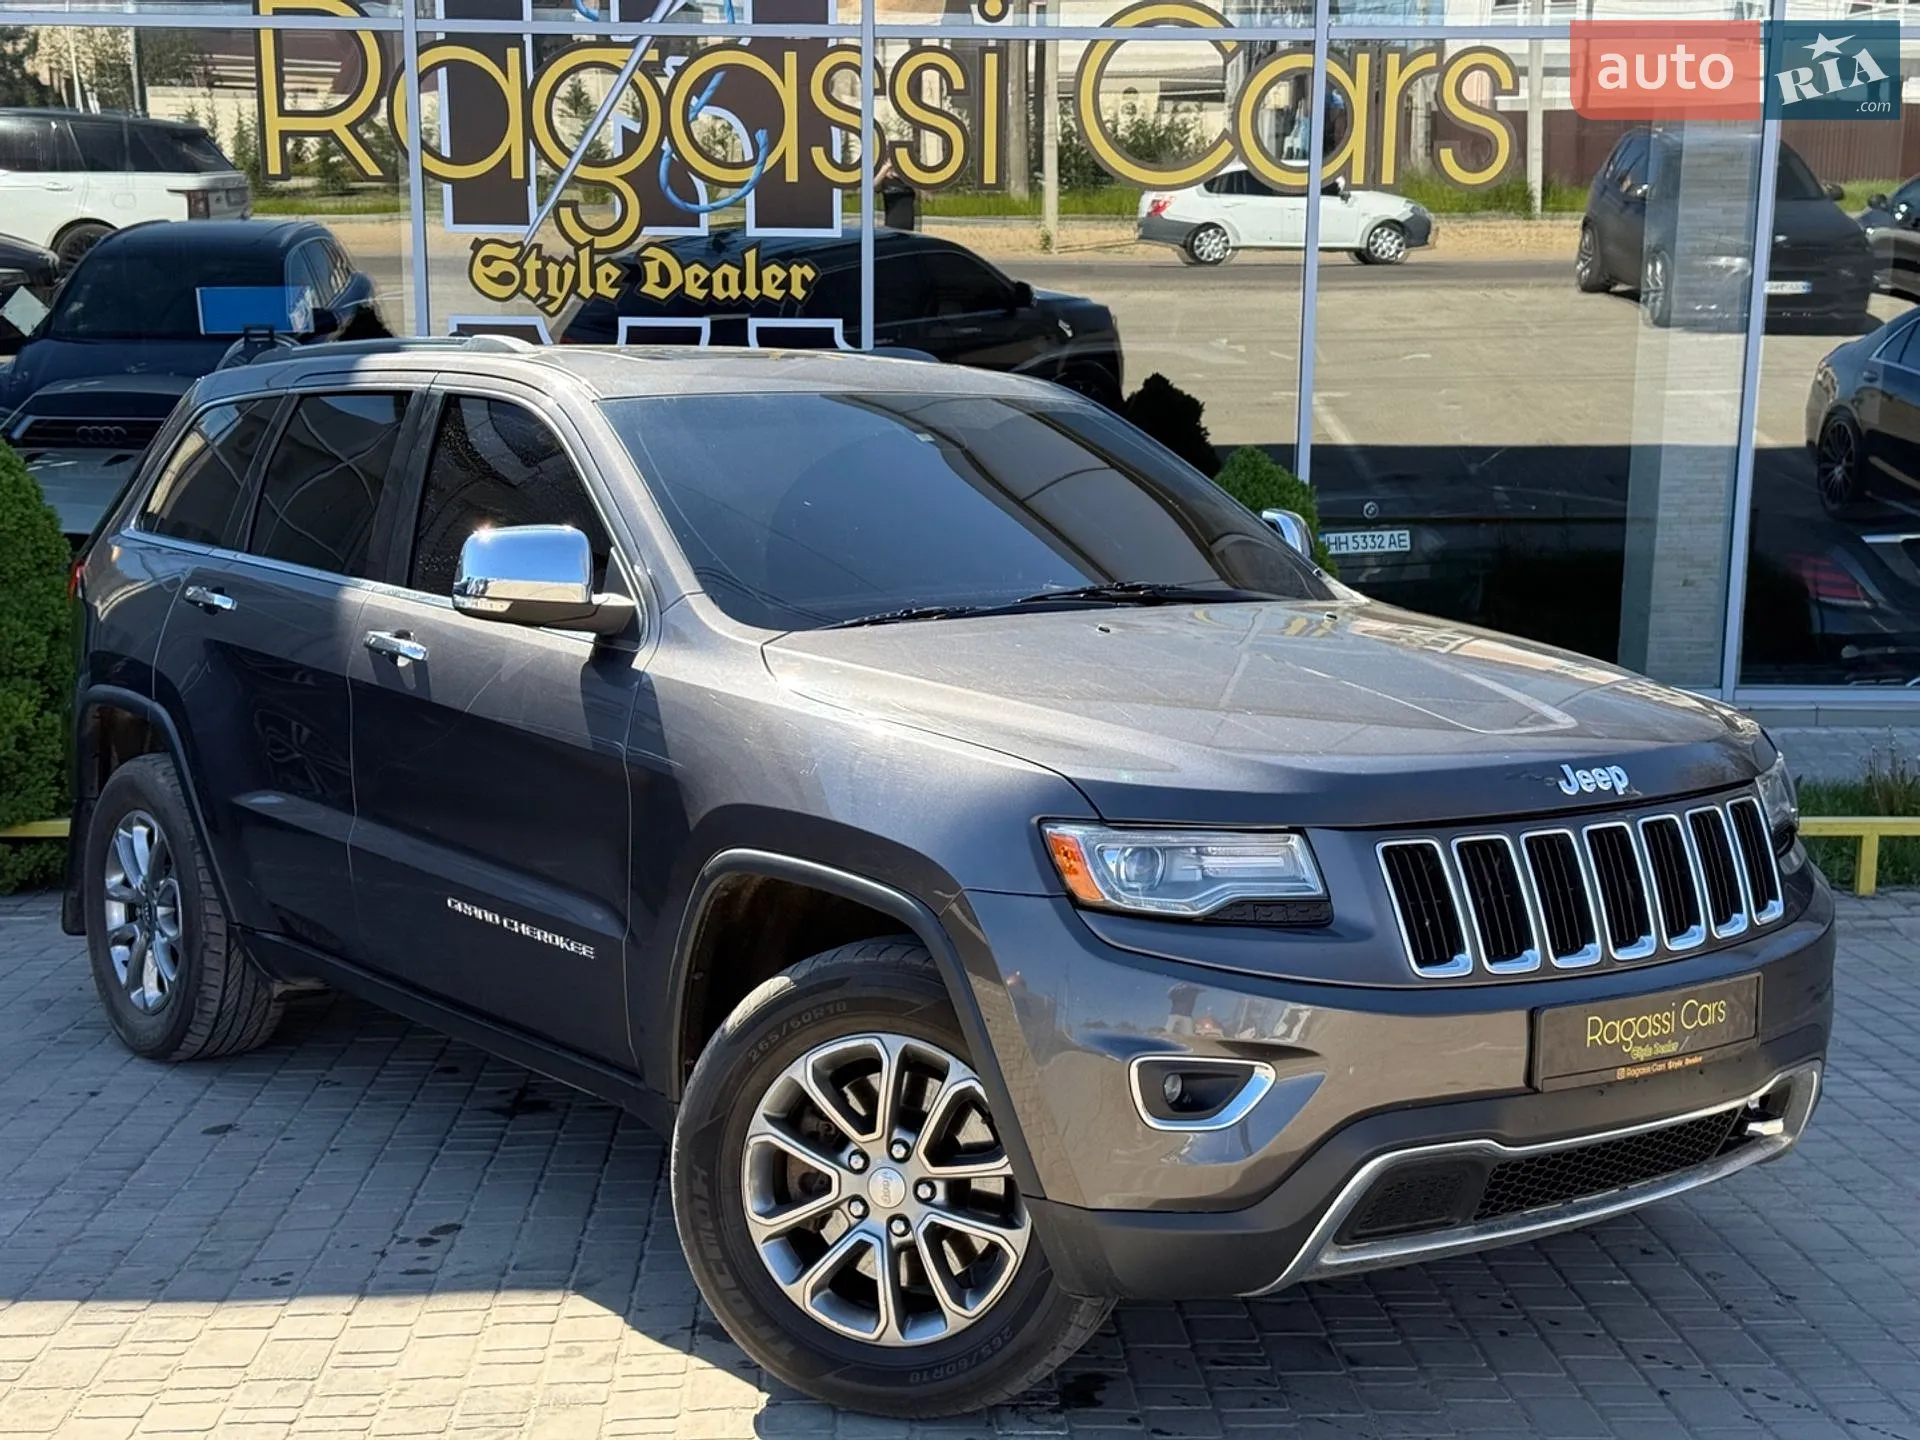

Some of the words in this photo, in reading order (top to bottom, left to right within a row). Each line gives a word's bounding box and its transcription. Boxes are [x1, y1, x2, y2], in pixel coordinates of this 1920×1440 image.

[257, 0, 1001, 251] Ragassi
[1078, 1, 1516, 190] Cars
[470, 237, 622, 315] Style
[637, 244, 818, 301] Dealer
[1351, 533, 1385, 551] 5332
[1387, 531, 1409, 549] AE
[1558, 763, 1630, 796] Jeep
[446, 896, 501, 925] GRAND
[502, 916, 596, 960] CHEROKEE
[1586, 1002, 1676, 1053] Ragassi
[1680, 999, 1728, 1031] Cars
